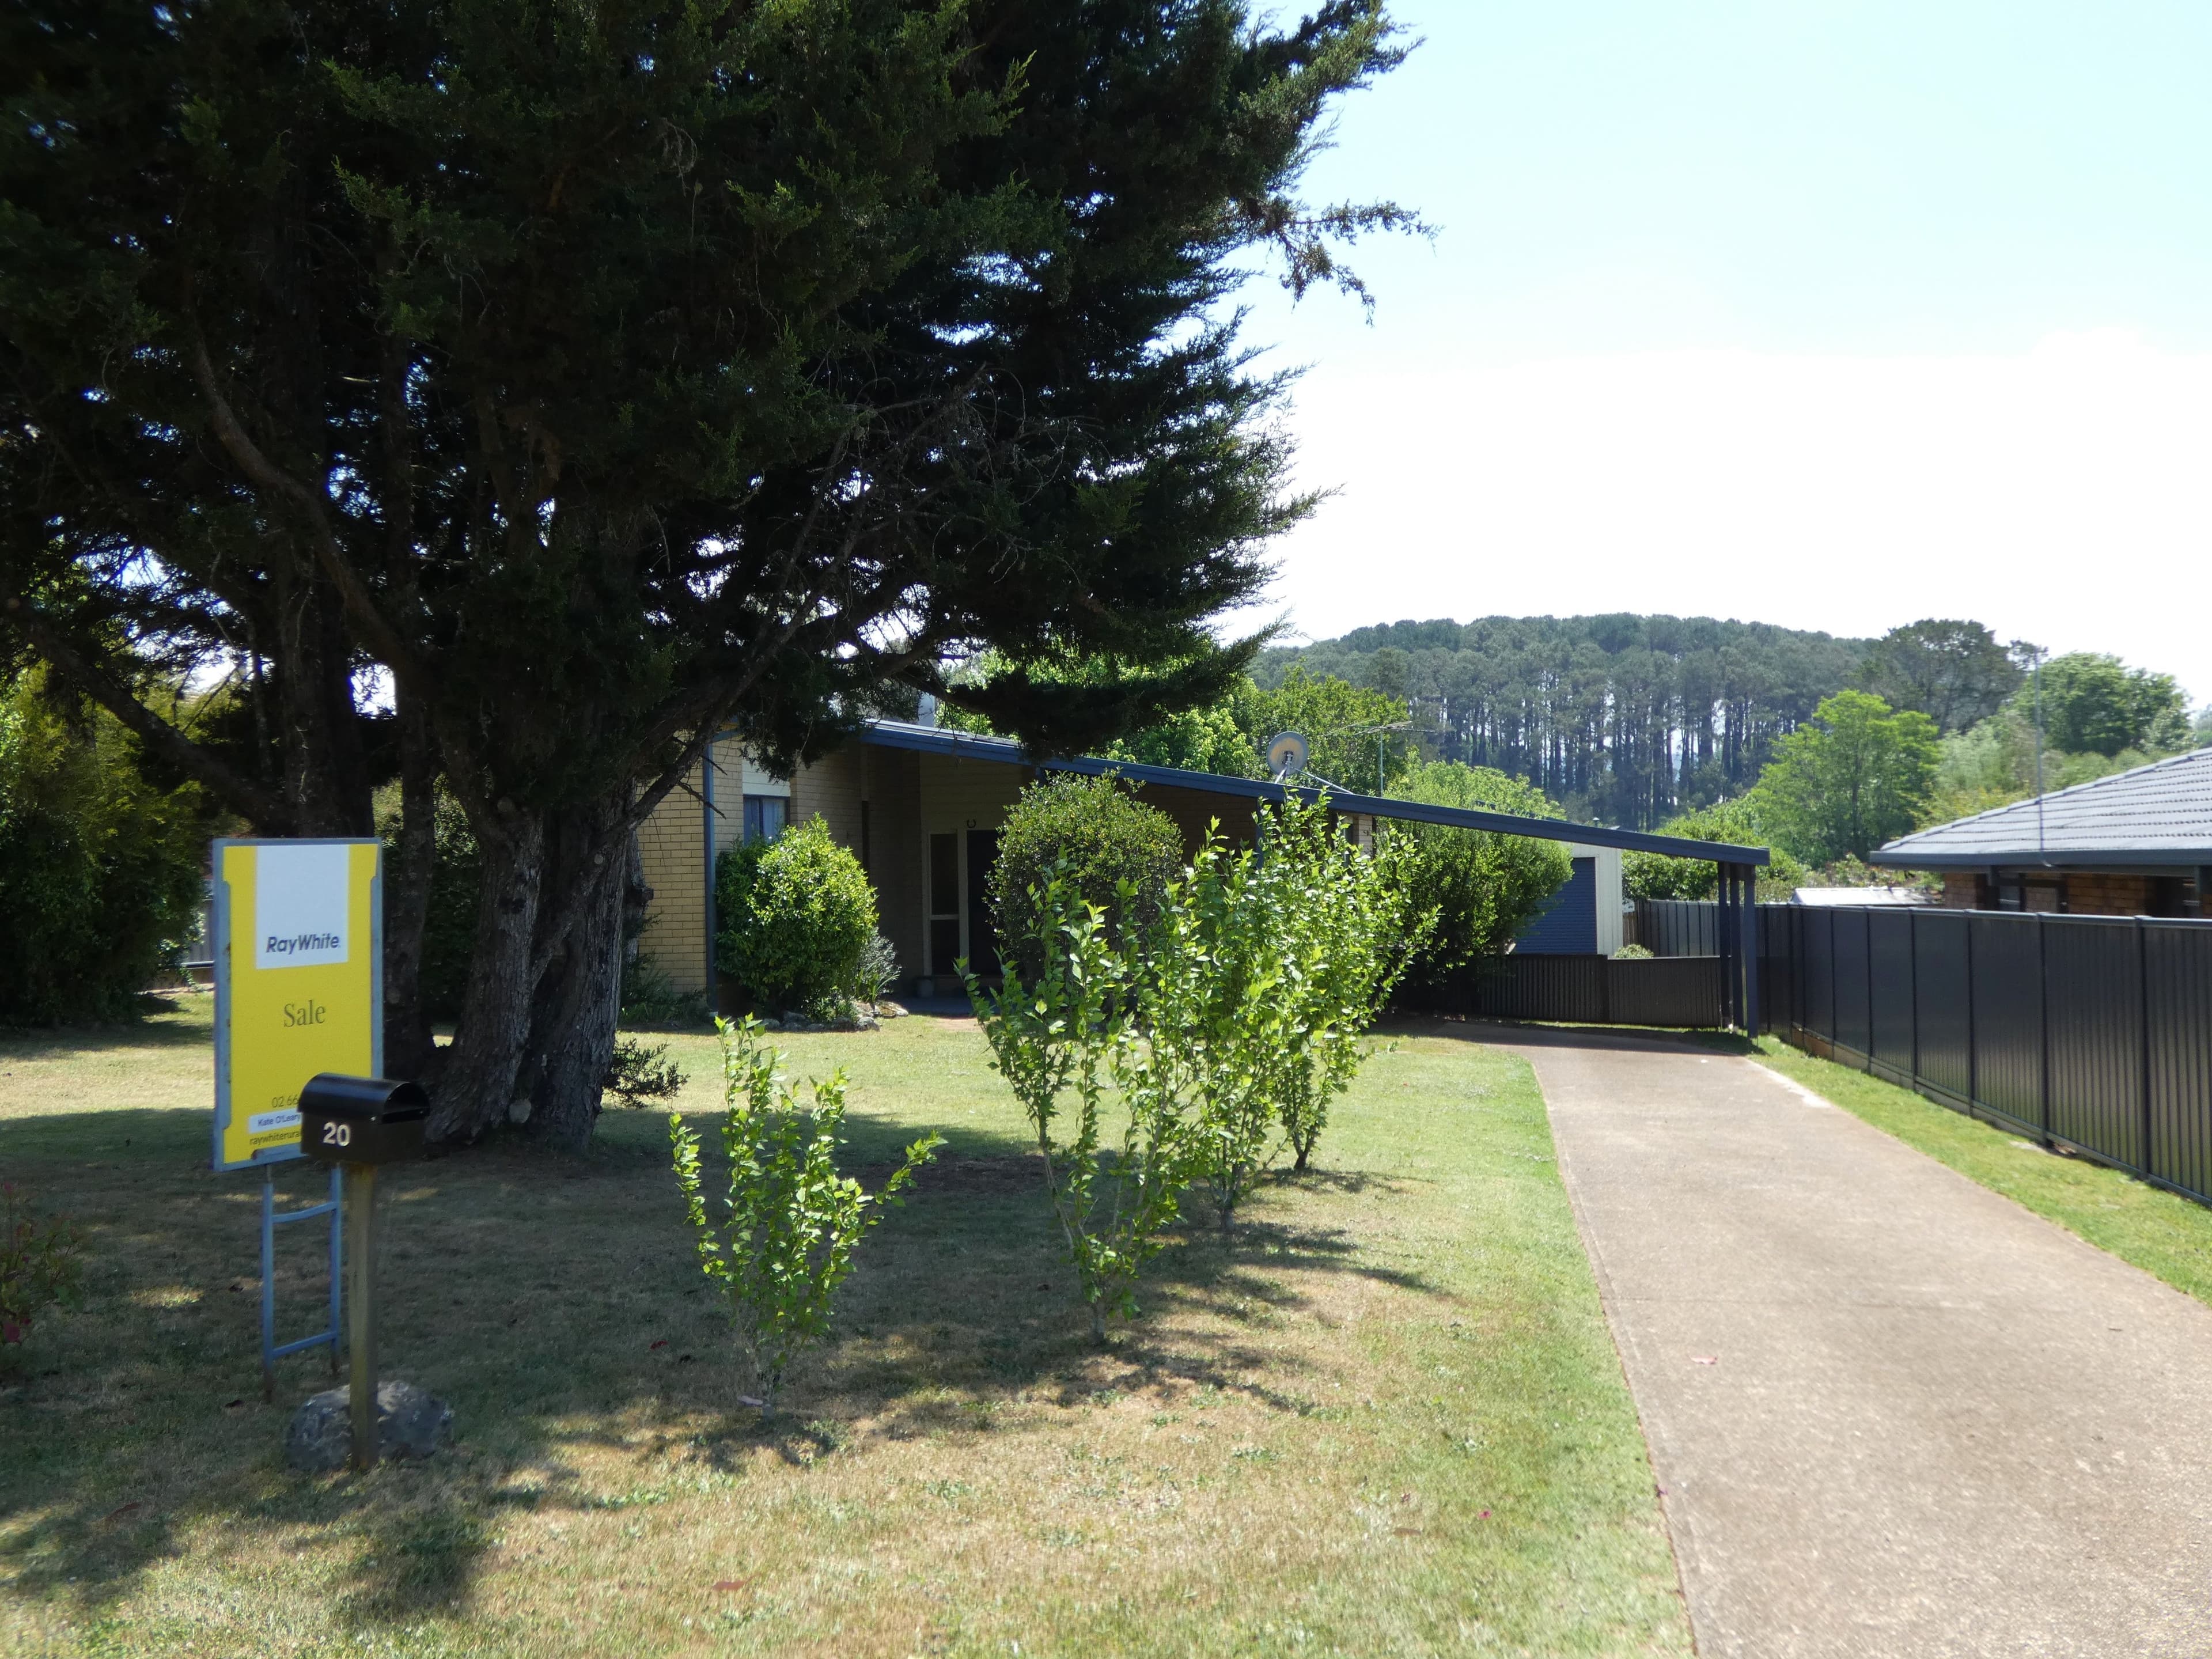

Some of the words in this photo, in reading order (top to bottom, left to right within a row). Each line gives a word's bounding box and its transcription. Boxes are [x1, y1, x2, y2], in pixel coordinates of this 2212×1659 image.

[283, 999, 326, 1028] Sale
[271, 1096, 284, 1108] 02
[323, 1122, 351, 1147] 20
